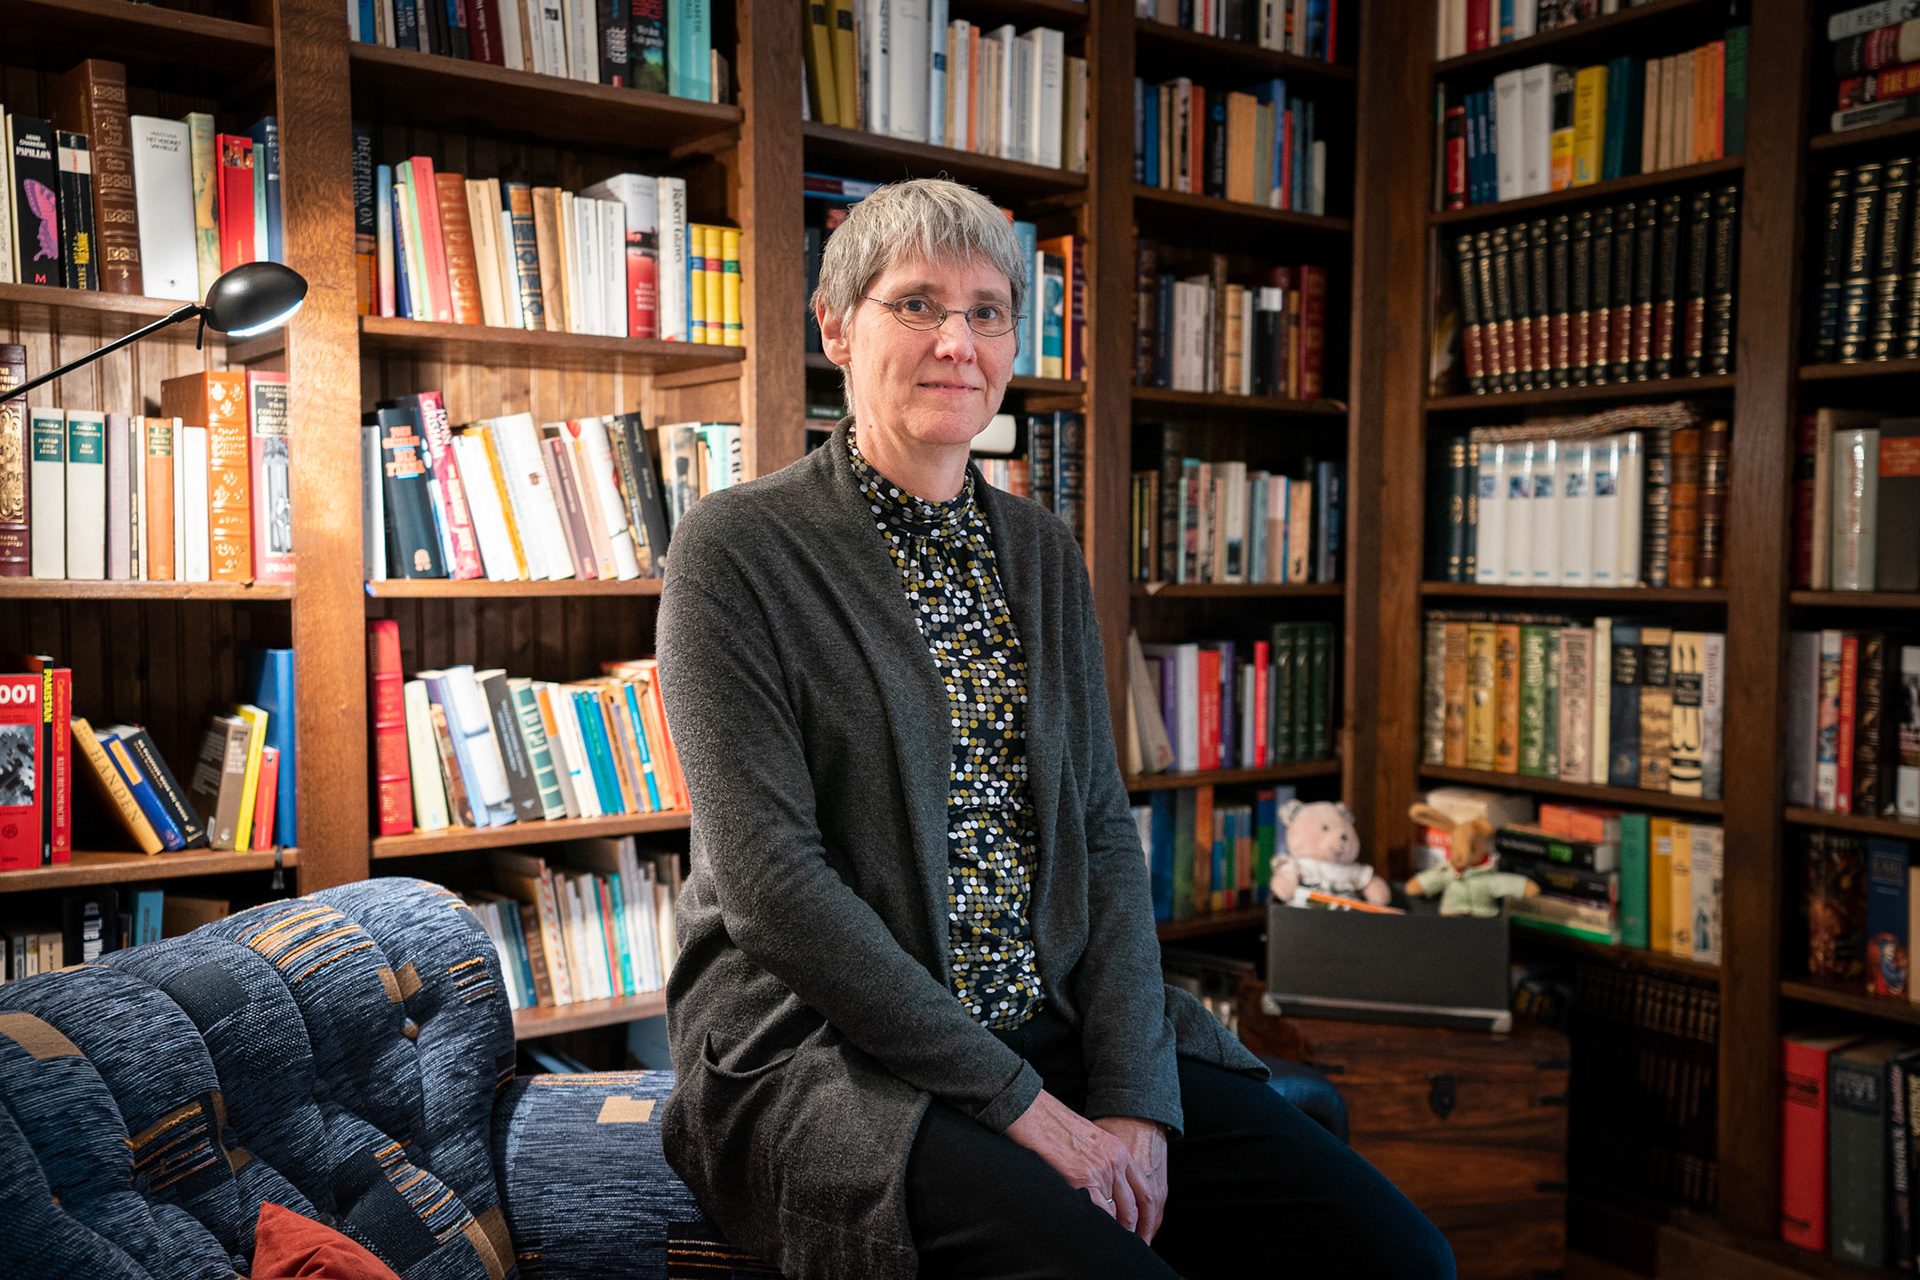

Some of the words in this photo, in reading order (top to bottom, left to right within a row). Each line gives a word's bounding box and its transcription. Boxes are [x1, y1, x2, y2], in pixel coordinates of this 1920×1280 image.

[15, 146, 53, 161] PAPILLON
[356, 135, 373, 204] DECEPTION
[359, 209, 374, 226] ON
[1851, 195, 1873, 273] Britannica
[1881, 191, 1903, 269] Britannica
[34, 273, 47, 285] M
[422, 399, 446, 460] GRISHAM
[43, 668, 54, 724] PAKISTAN
[90, 748, 142, 823] HANDEN
